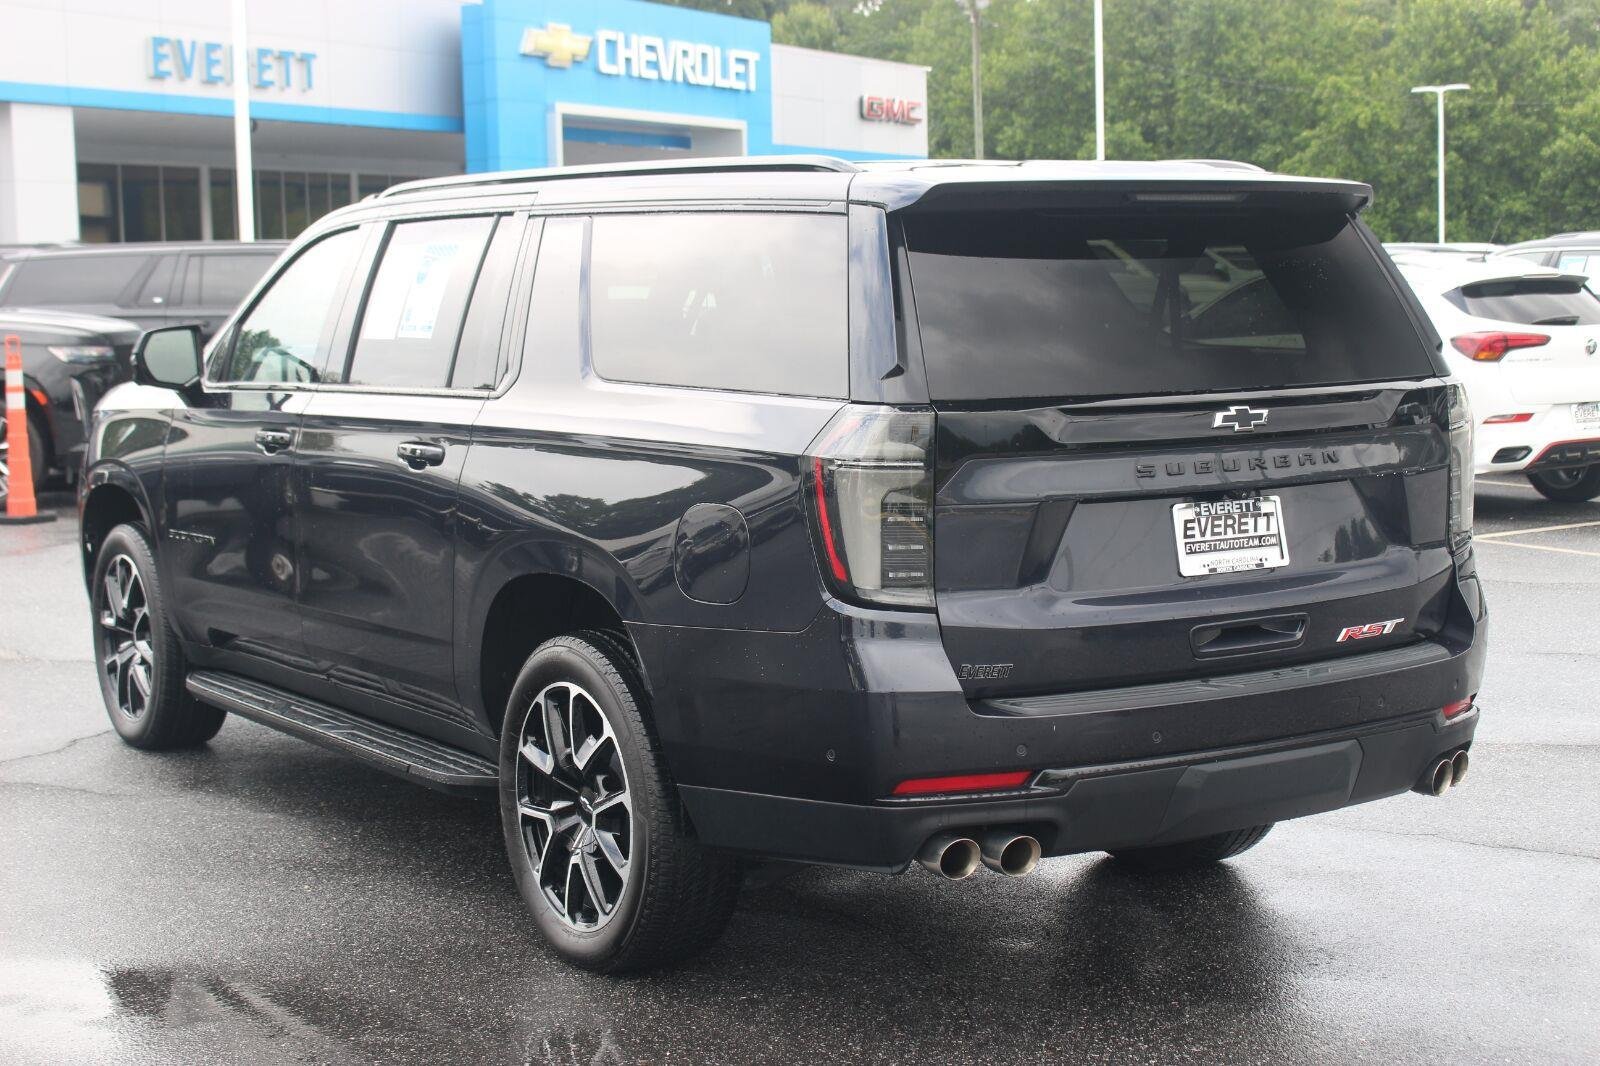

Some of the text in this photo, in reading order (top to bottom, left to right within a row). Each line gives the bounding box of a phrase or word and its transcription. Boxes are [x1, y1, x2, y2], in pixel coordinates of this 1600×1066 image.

[149, 36, 317, 91] EVEETT
[595, 29, 760, 92] CHEVROLET
[860, 95, 923, 126] GMC
[1135, 449, 1340, 479] SUBURBAN
[1201, 499, 1255, 516] EVERETT
[1183, 512, 1275, 540] EVERETT
[1186, 536, 1277, 553] EVERETTAUTOTEAM.COM
[1336, 617, 1405, 643] RST
[958, 663, 1014, 680] EVERETT
